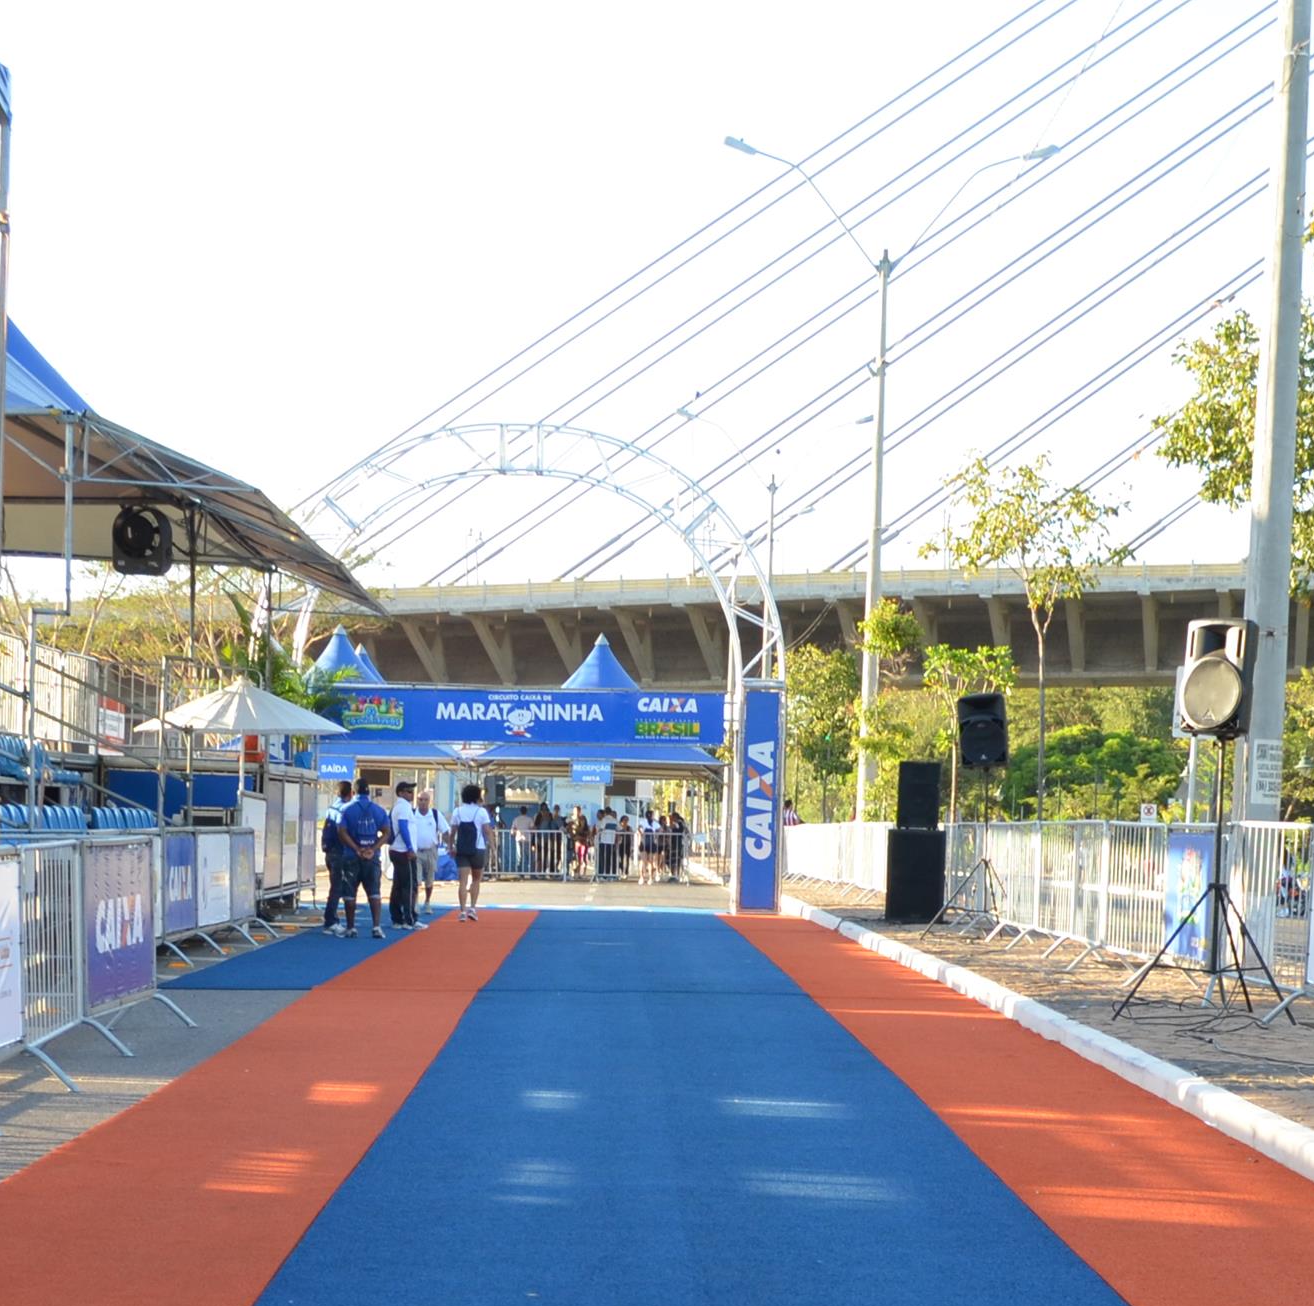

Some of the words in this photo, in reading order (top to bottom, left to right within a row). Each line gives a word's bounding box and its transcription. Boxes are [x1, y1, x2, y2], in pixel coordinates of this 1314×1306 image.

[543, 694, 552, 702] DE
[637, 697, 698, 713] CAIXA
[321, 764, 348, 774] SAÍDA
[573, 764, 611, 773] RECEPÇÃO
[744, 739, 775, 861] CAIXA
[95, 893, 144, 954] CAIXA
